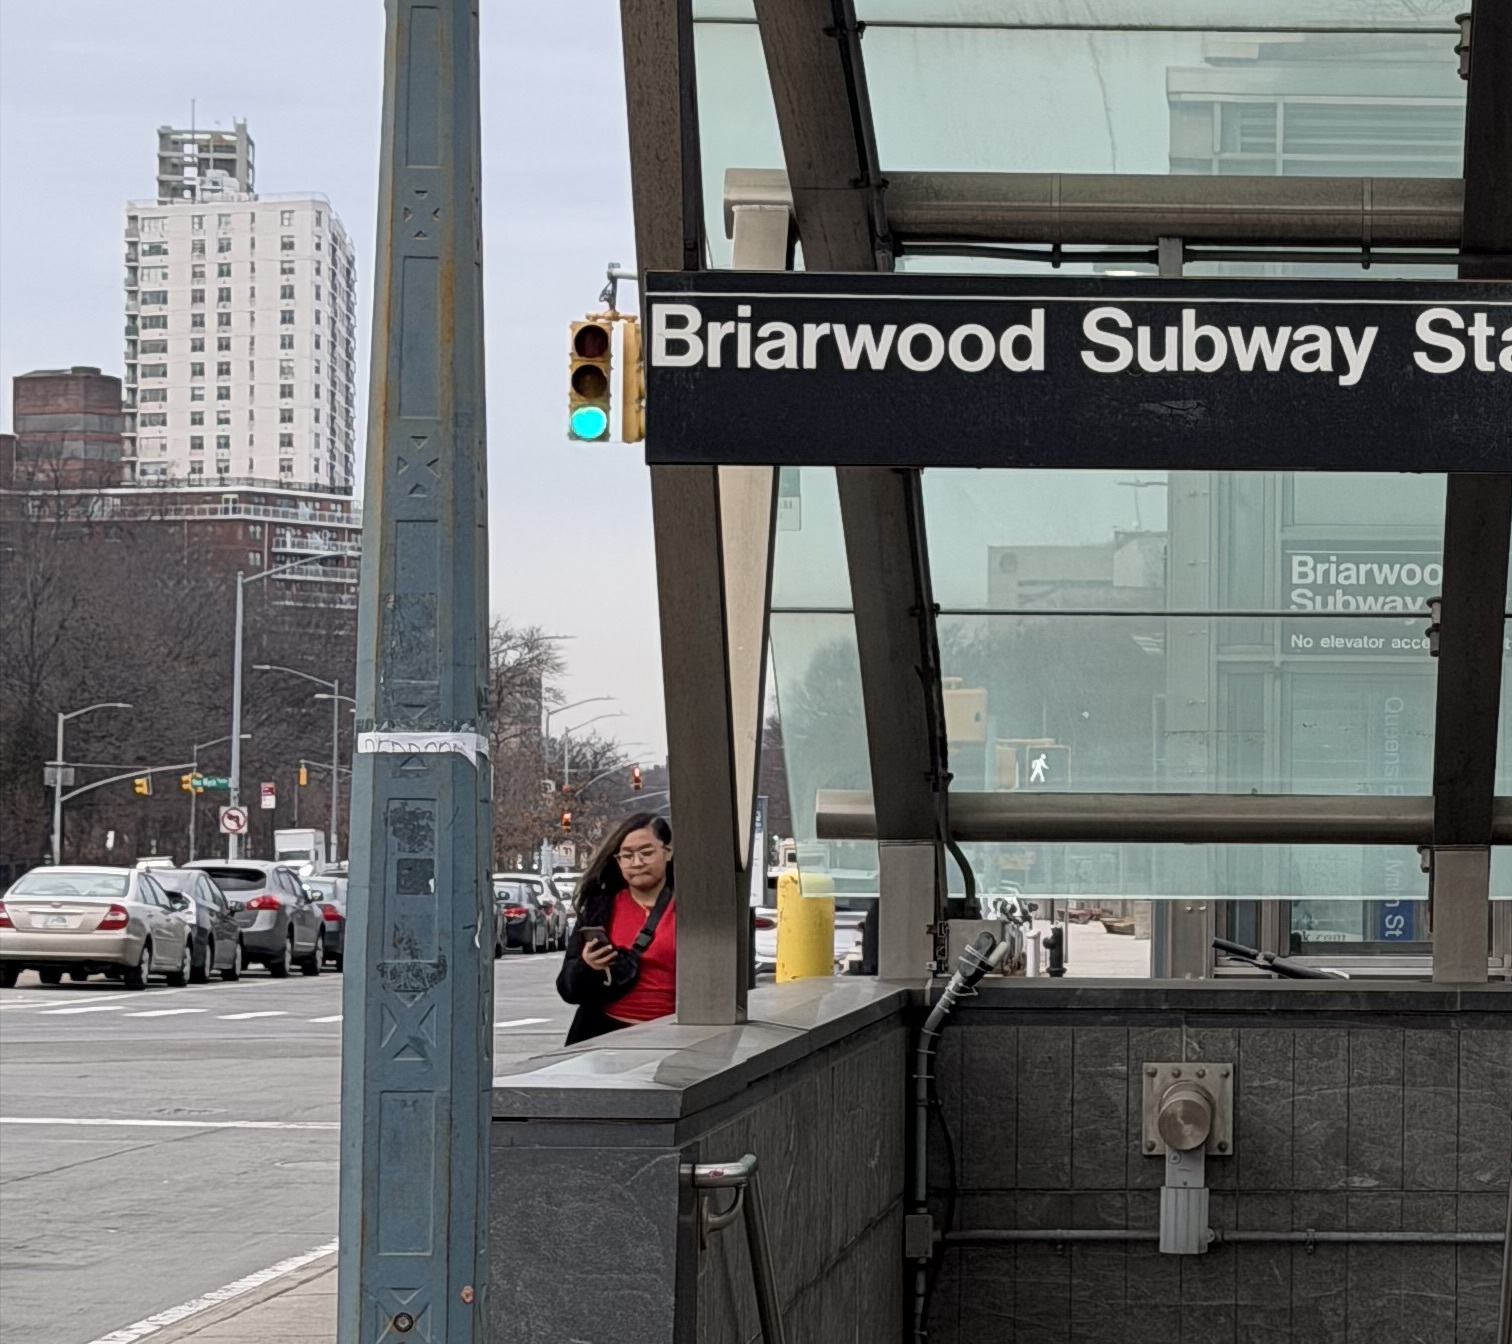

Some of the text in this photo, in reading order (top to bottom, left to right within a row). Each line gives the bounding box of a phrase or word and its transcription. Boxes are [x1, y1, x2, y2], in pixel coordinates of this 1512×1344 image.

[650, 302, 1047, 371] Briarwood
[1080, 307, 1379, 386] Subway
[1290, 555, 1443, 586] Briarwoo
[1290, 634, 1313, 650] No
[1320, 634, 1385, 651] elevator
[1391, 637, 1431, 650] acce
[1384, 914, 1405, 937] St
